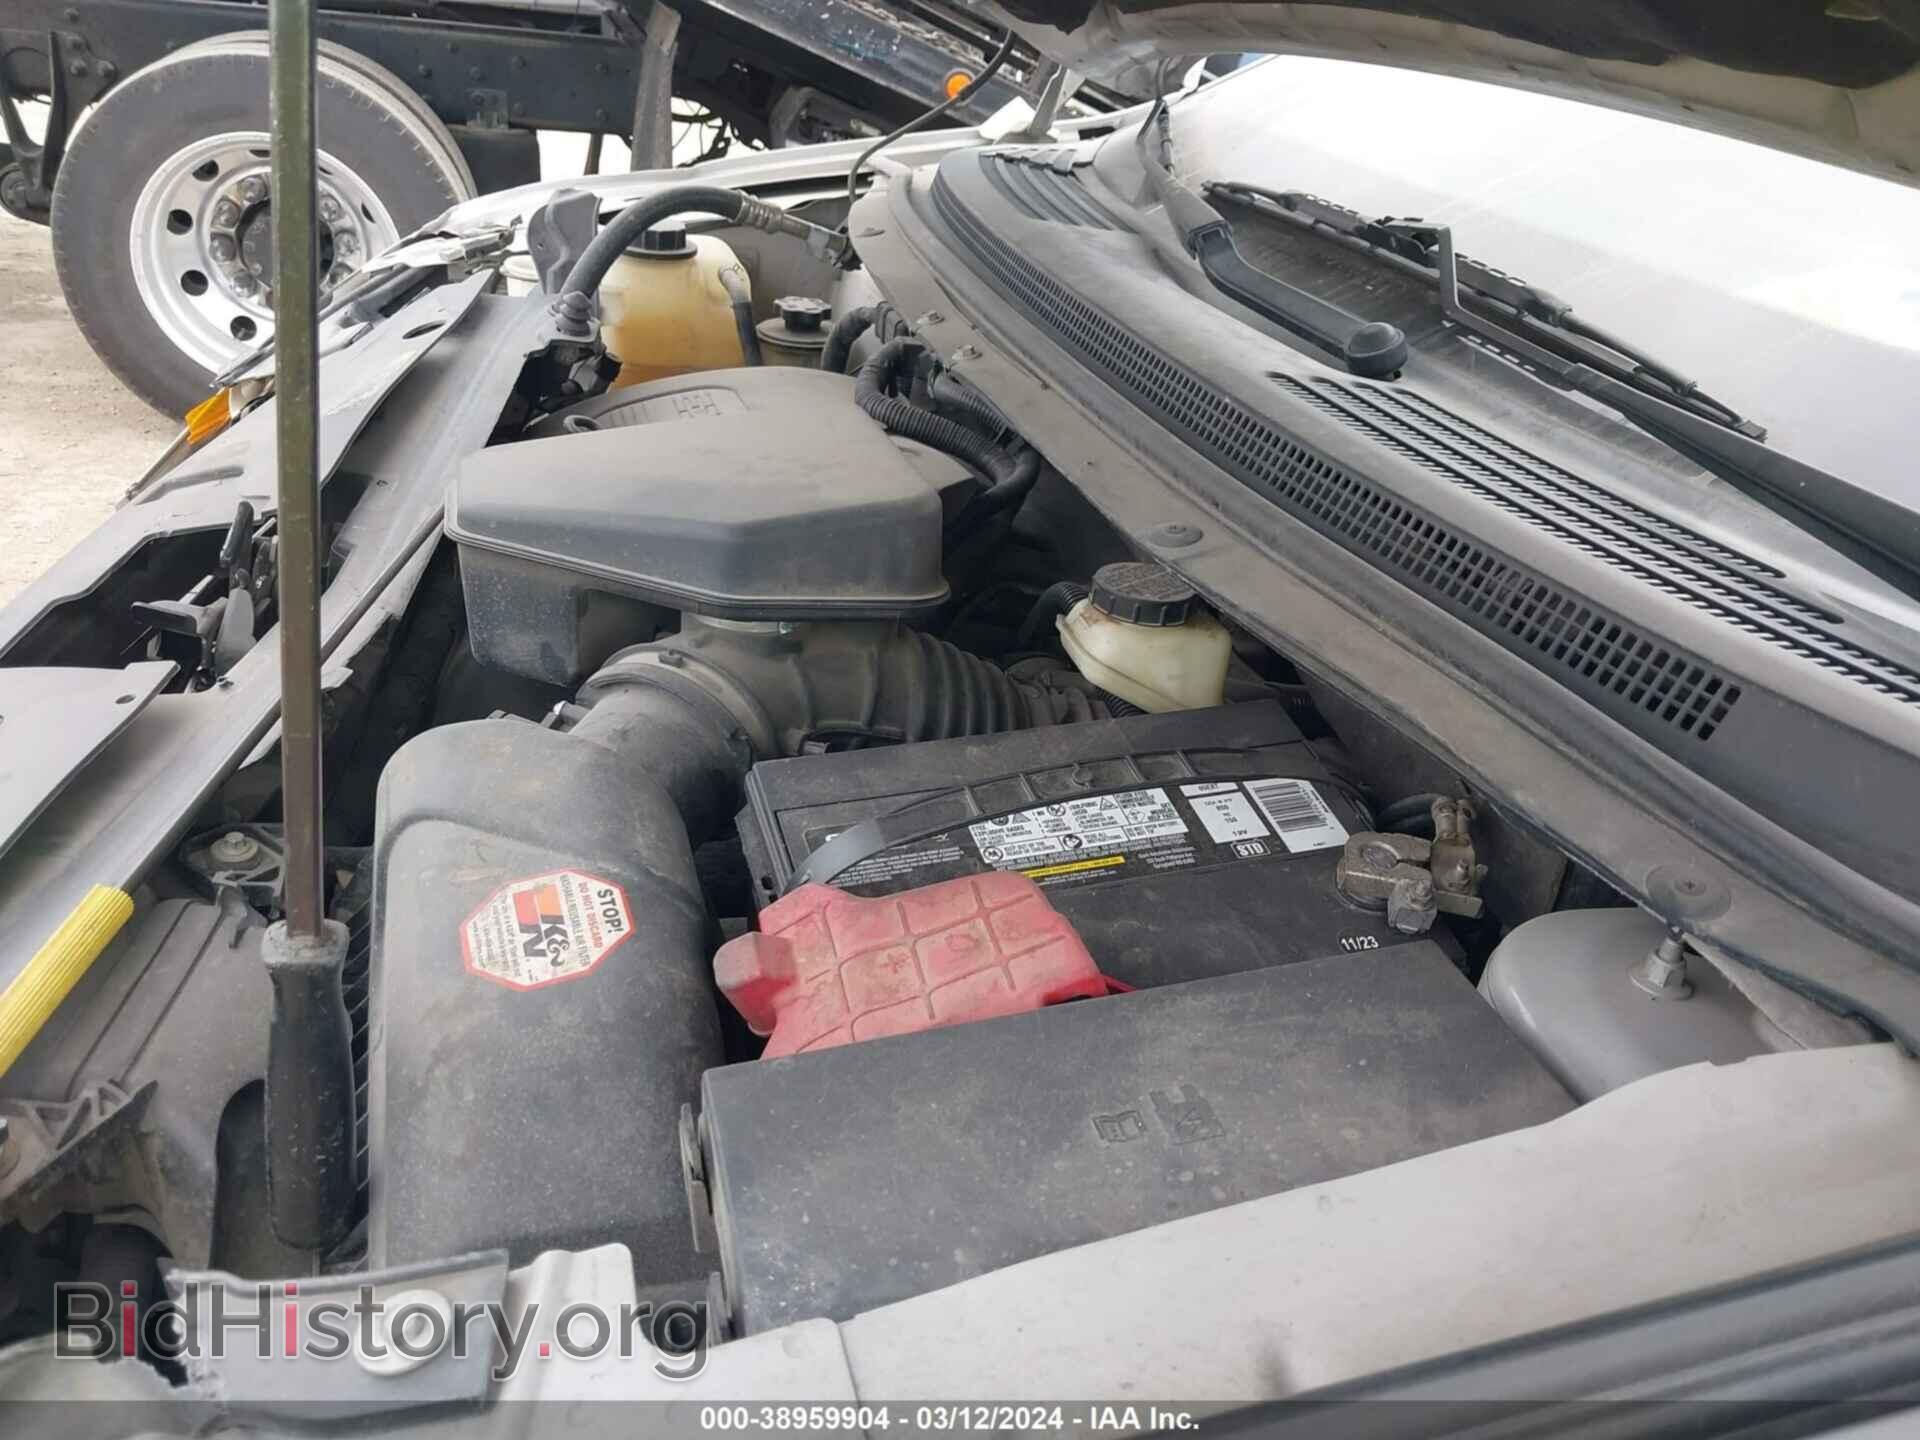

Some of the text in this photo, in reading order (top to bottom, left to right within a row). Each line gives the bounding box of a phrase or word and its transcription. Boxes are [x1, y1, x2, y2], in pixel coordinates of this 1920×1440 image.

[1236, 842, 1264, 857] STD
[581, 894, 594, 910] NOT
[597, 888, 624, 933] STOP!
[586, 911, 604, 948] DISCARD
[1341, 935, 1379, 950] 11/23
